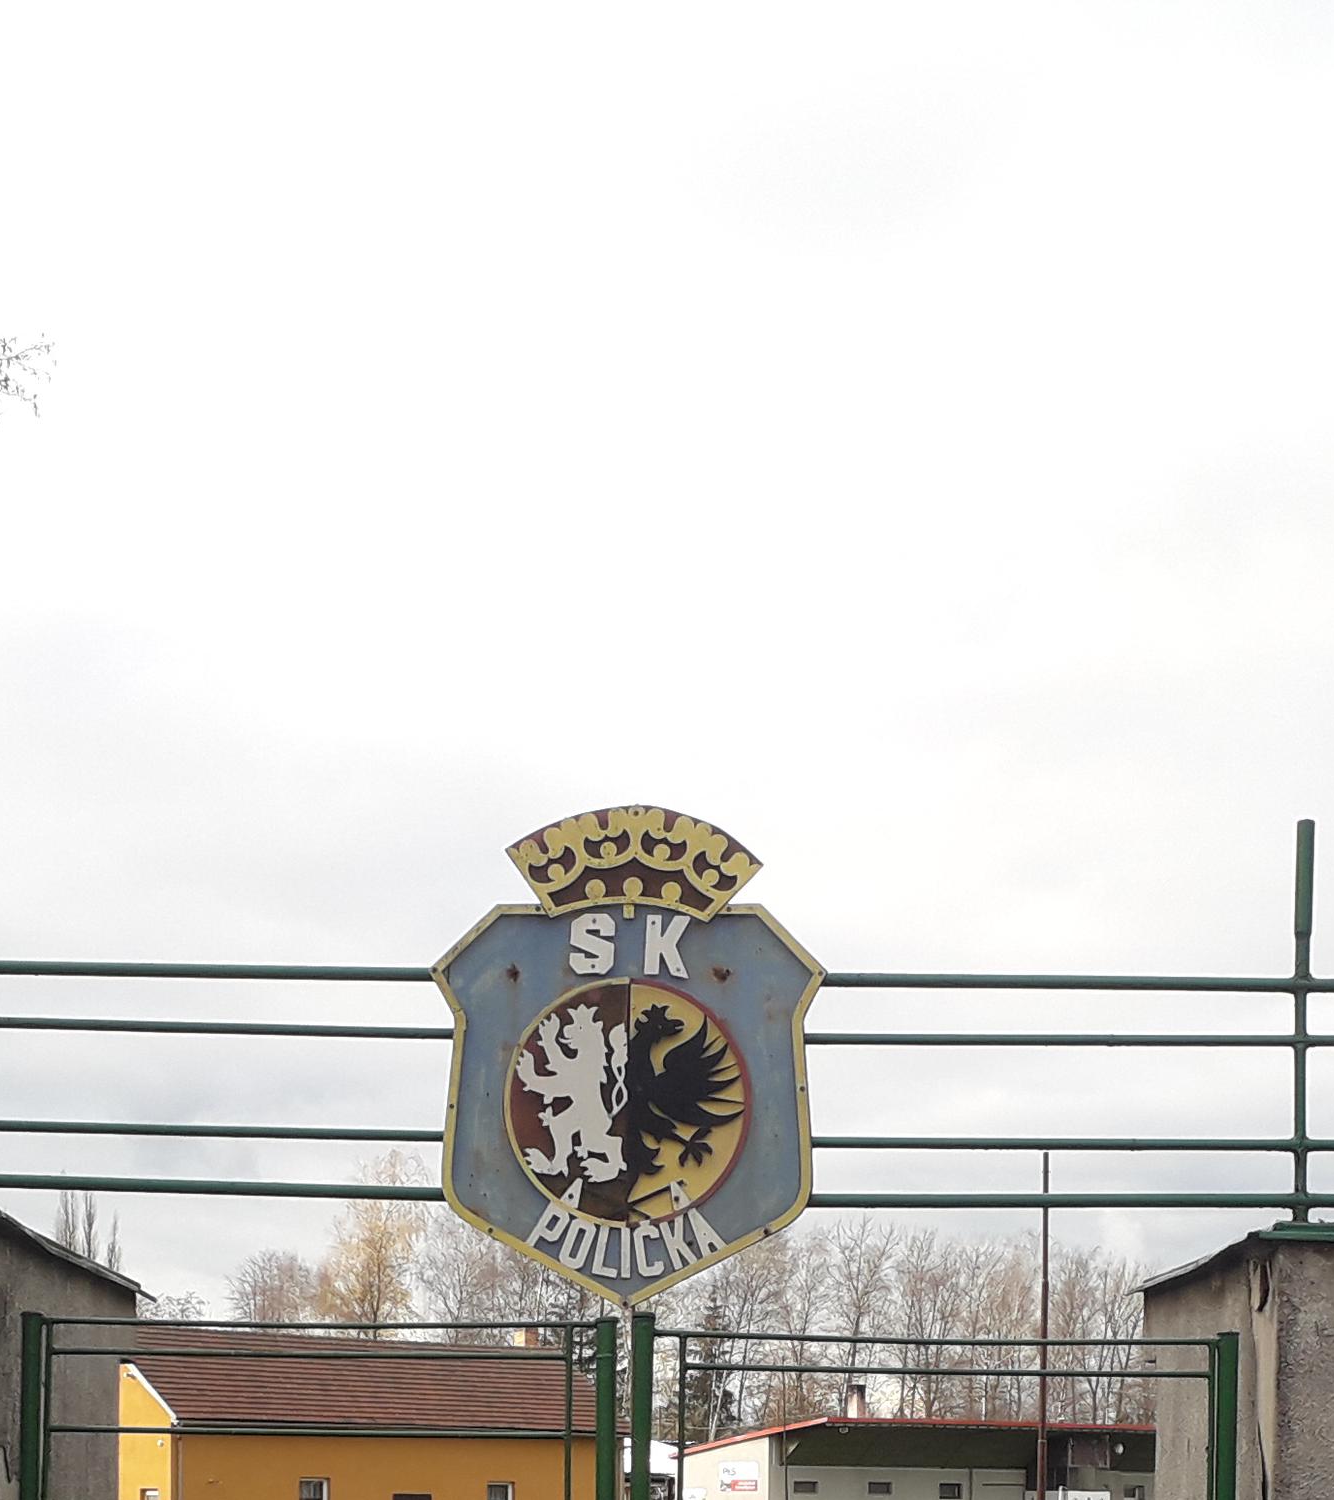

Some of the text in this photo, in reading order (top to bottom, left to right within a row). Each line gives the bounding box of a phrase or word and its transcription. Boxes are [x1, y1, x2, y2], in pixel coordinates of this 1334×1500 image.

[569, 913, 689, 979] S K
[526, 1200, 728, 1279] POLIČKA
